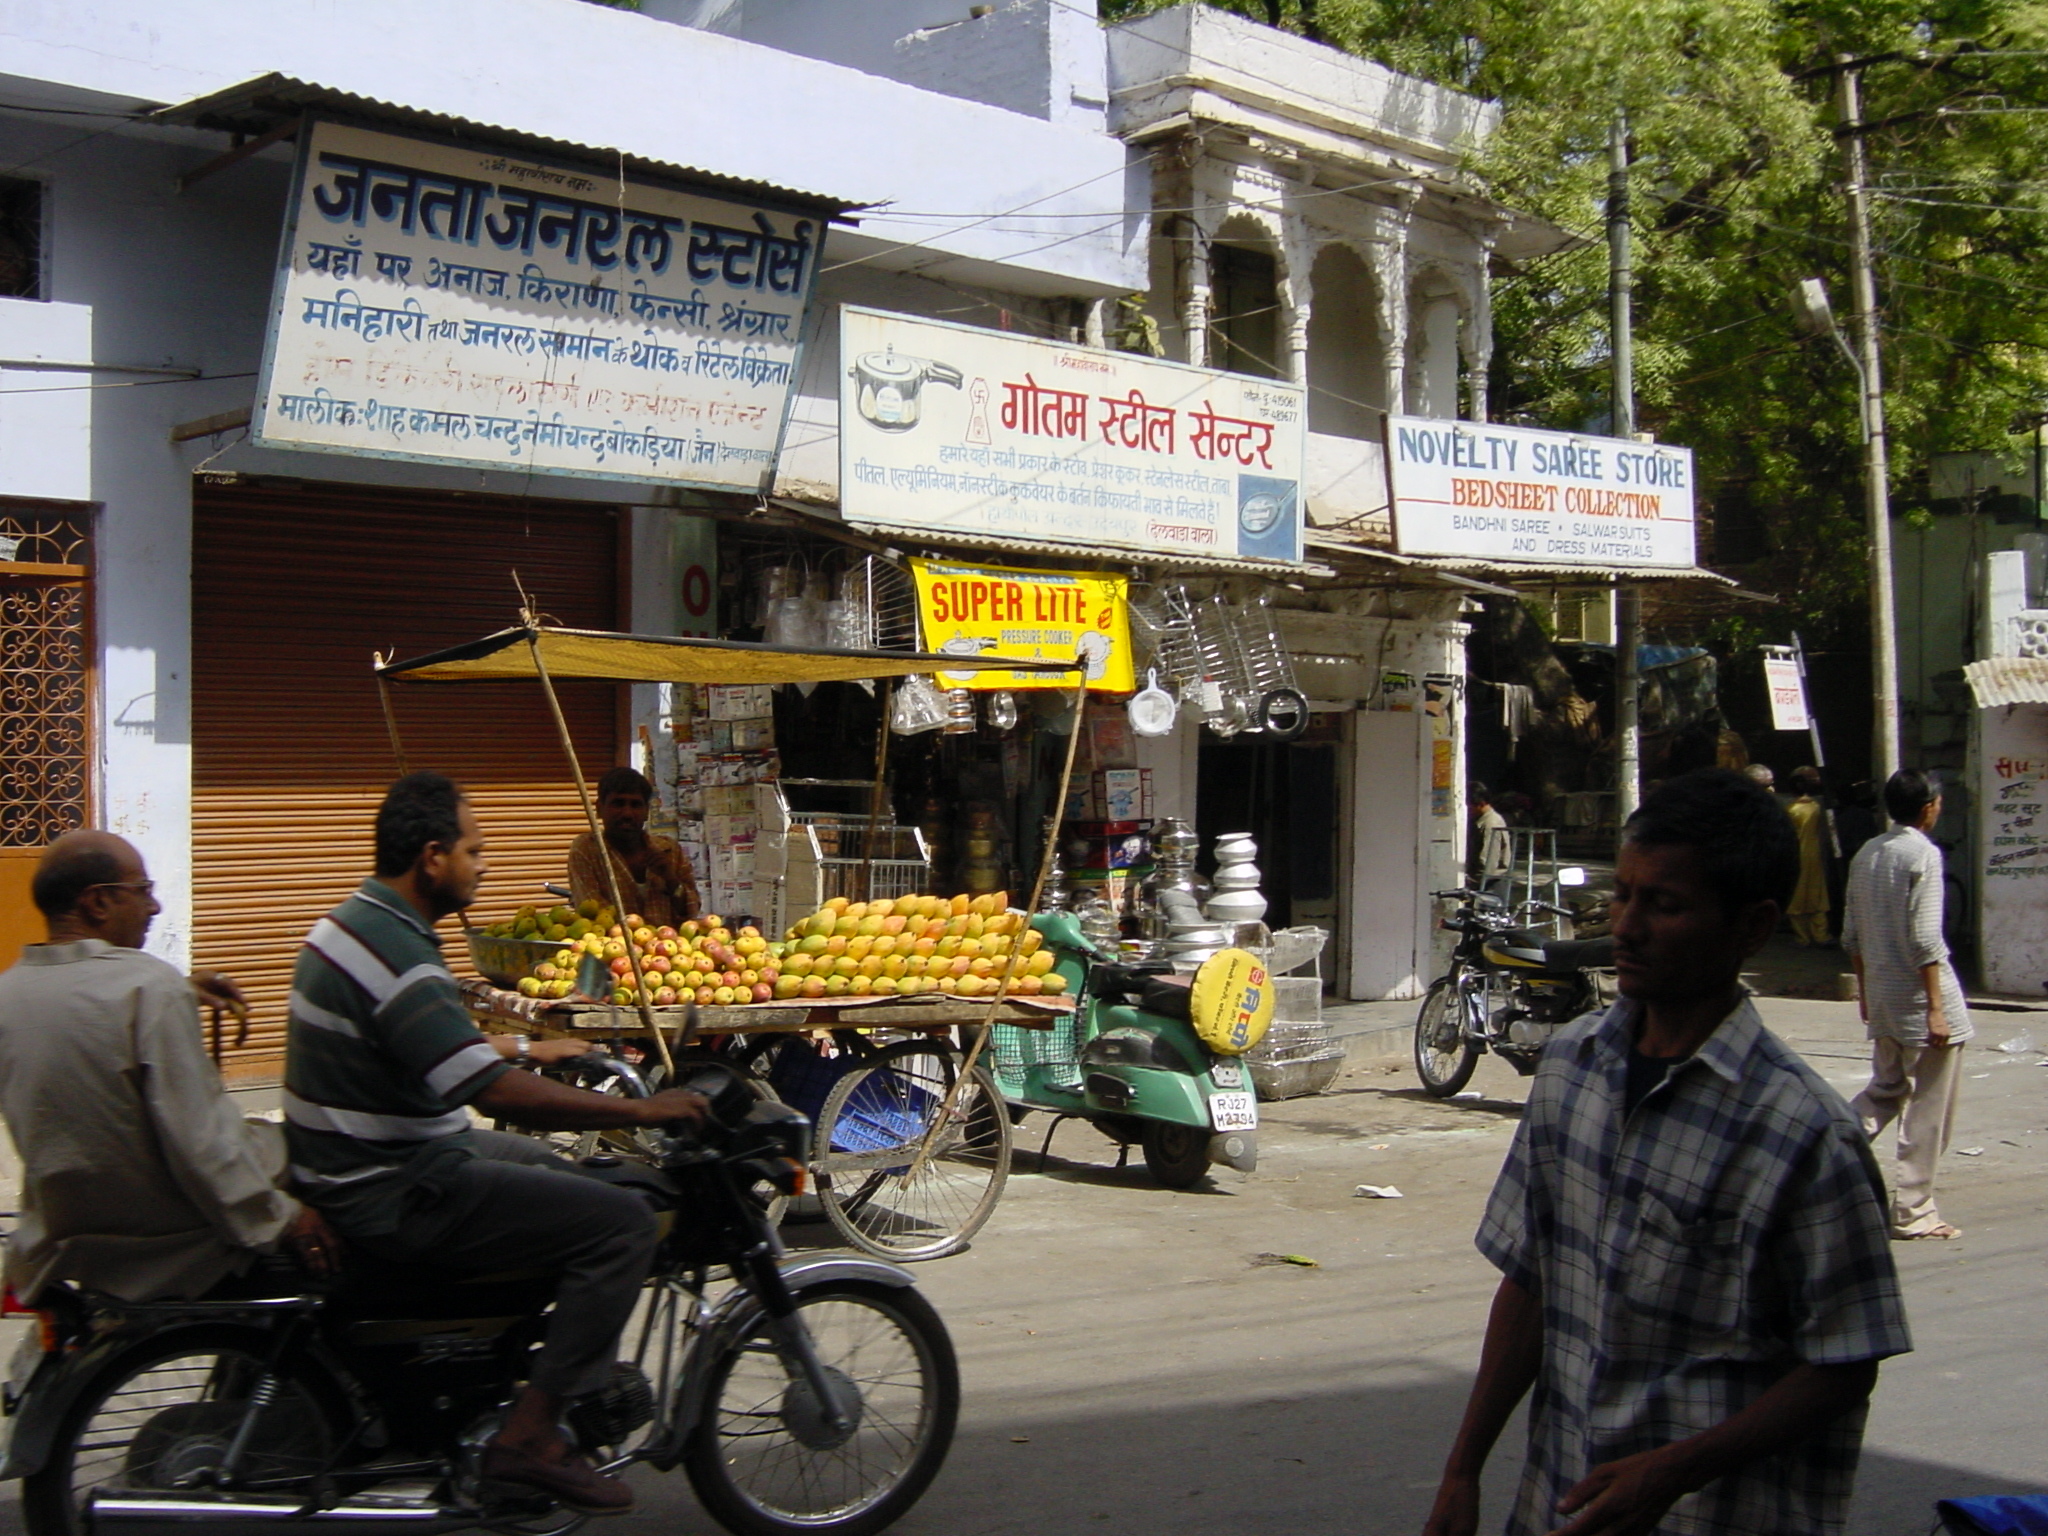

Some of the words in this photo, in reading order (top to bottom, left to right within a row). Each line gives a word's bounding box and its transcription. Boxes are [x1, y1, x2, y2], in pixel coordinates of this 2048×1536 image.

[313, 151, 495, 247] जनता
[485, 184, 684, 277] जनरल
[687, 211, 813, 298] स्टोर्स
[307, 235, 364, 281] यहाँ
[374, 252, 412, 286] पर
[302, 288, 429, 343] मनिहारी
[429, 319, 460, 343] तथा
[459, 319, 536, 356] जनरल
[611, 336, 629, 364] के
[630, 329, 680, 373] थोक
[682, 355, 692, 376] व
[364, 398, 407, 440] शाह
[1001, 372, 1089, 442] गोतम
[1099, 389, 1176, 455] स्टील
[1188, 400, 1275, 470] सेन्टर
[939, 443, 969, 465] हमारे
[992, 446, 1015, 469] सभी
[1018, 452, 1049, 472] प्रकार
[1050, 456, 1061, 473] के
[1398, 427, 1518, 472] NOVELTY
[1532, 442, 1603, 480] SAREE
[1616, 452, 1685, 488] STORE
[1057, 481, 1069, 501] के
[1164, 494, 1174, 517] से
[1175, 495, 1205, 520] मिलते
[1452, 478, 1559, 512] BEDSHEET
[1565, 487, 1661, 521] COLLECTION
[1453, 515, 1507, 532] BANDHNI
[1511, 519, 1550, 535] SAREE
[1512, 538, 1537, 552] AND
[1547, 540, 1586, 555] DRESS
[1590, 541, 1653, 559] MATERIALS
[931, 581, 1023, 623] SUPER
[1033, 584, 1087, 625] LITE
[1001, 630, 1041, 644] PRESSURE
[1044, 630, 1073, 645] COOKER
[1217, 1098, 1247, 1110] RJ27
